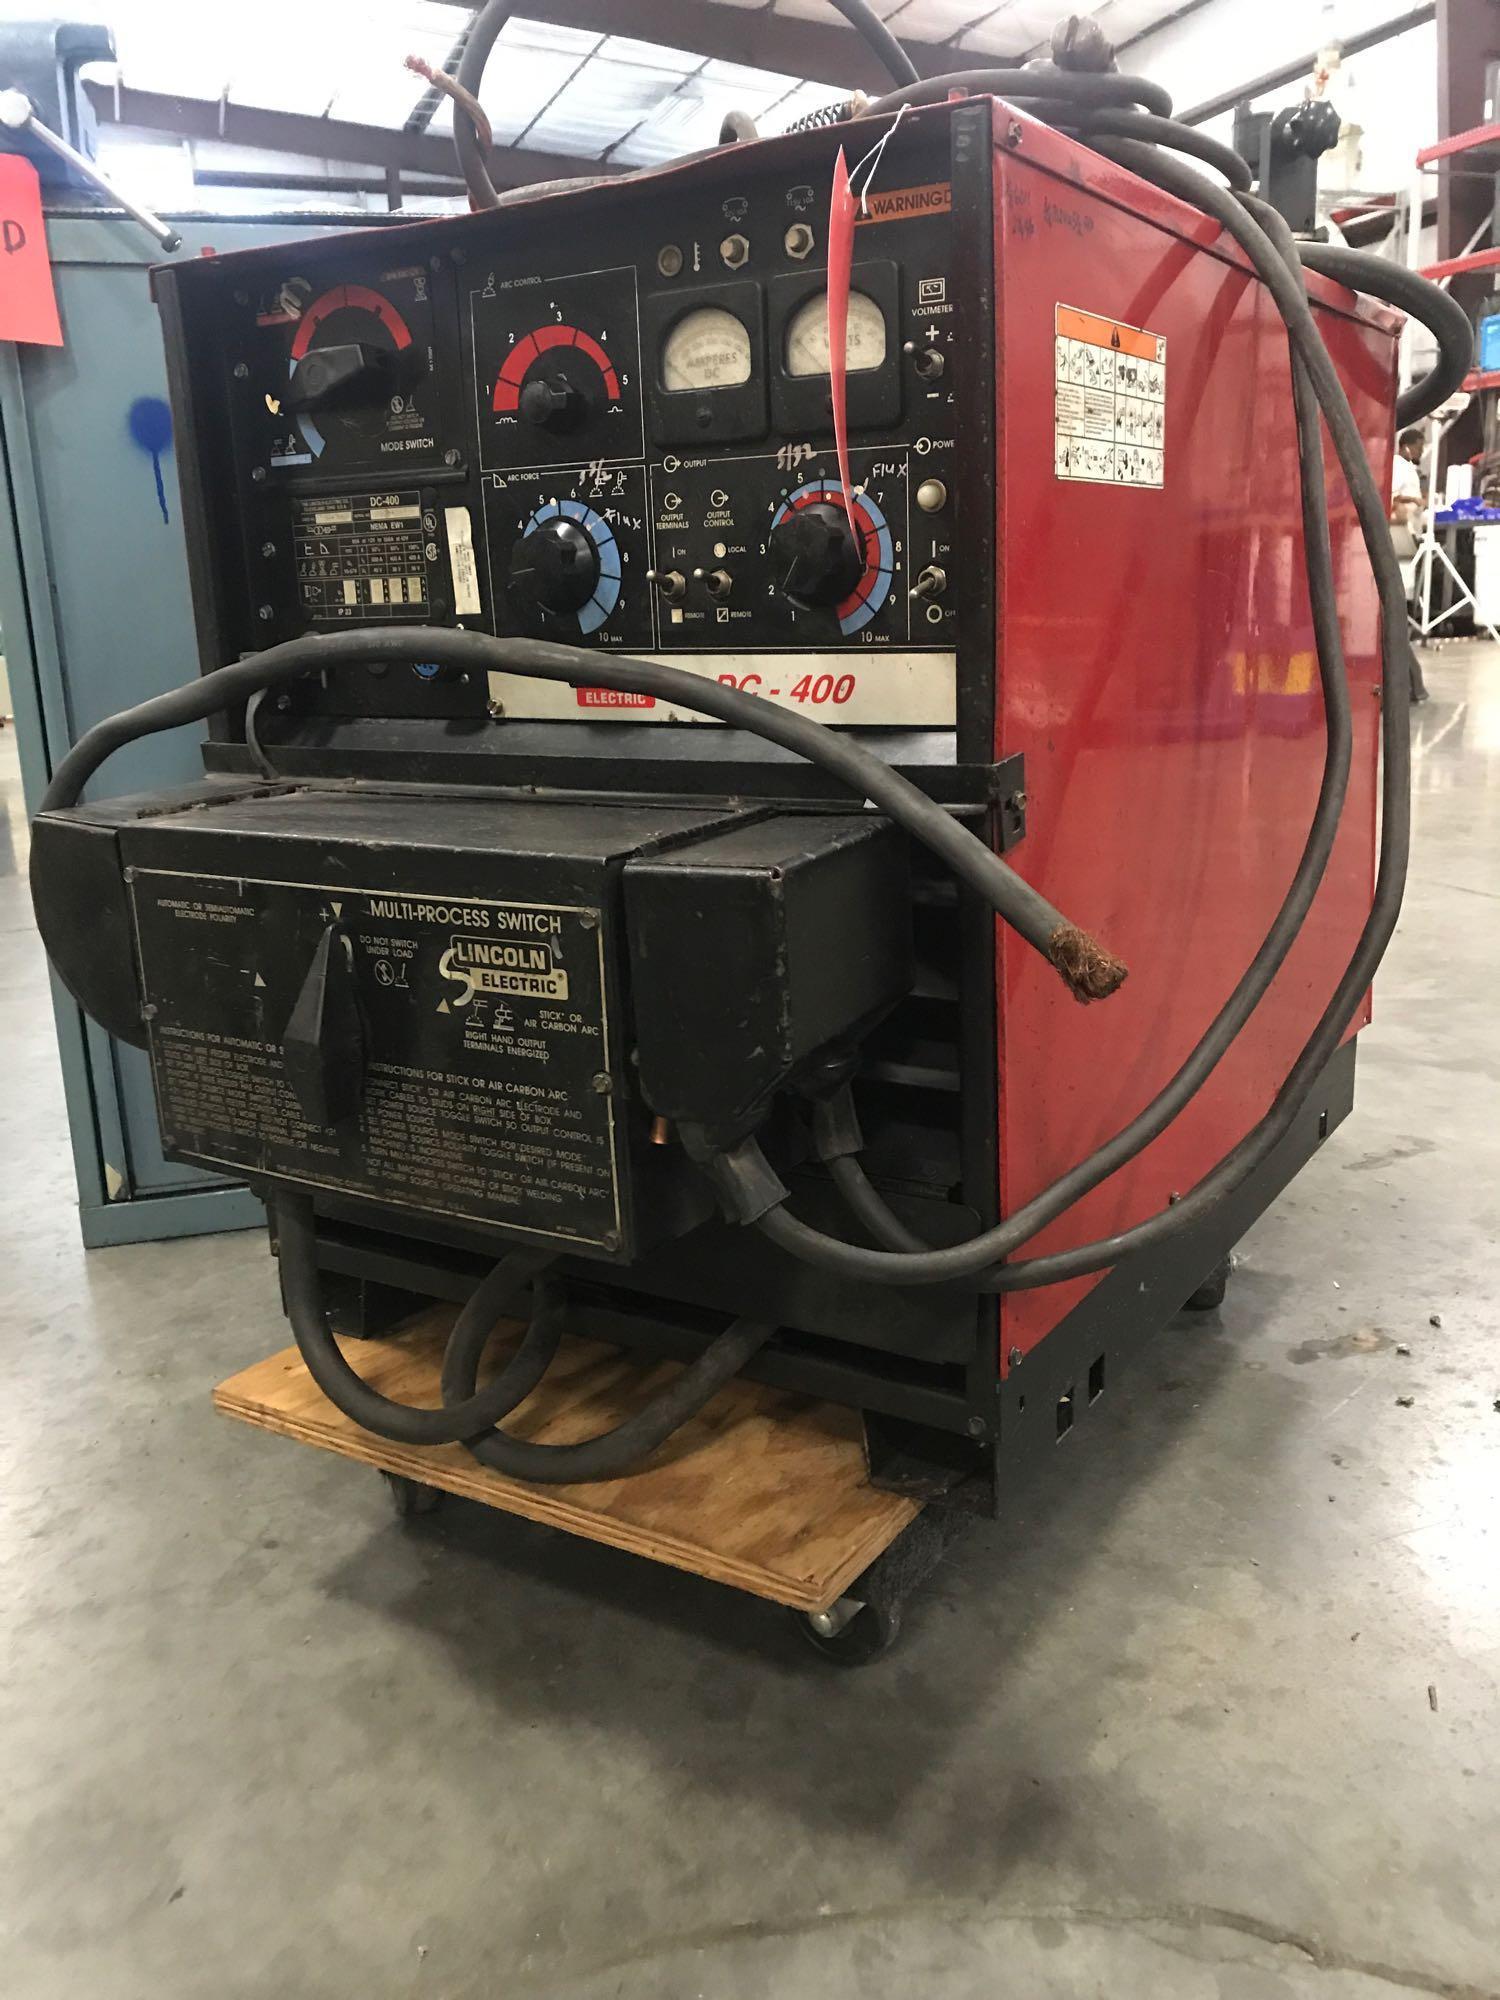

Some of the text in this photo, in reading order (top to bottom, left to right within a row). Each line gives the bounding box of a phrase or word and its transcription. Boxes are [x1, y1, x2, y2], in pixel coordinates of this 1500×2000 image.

[873, 190, 943, 214] WARNING
[500, 276, 542, 289] ARC CONTROL
[556, 311, 563, 322] 3
[912, 304, 954, 317] VOLTMETER
[508, 332, 515, 344] 2
[600, 330, 607, 342] 4
[686, 351, 737, 368] AMPERES
[704, 366, 720, 379] DC
[622, 374, 629, 386] 5
[485, 385, 490, 395] 1
[380, 437, 434, 452] MODE SWITCH
[932, 439, 955, 449] POWE
[684, 459, 707, 469] OUTPUT
[507, 472, 540, 482] ARC FORCE
[797, 472, 804, 484] 5
[570, 488, 577, 498] 6
[877, 492, 884, 503] 7
[369, 495, 400, 507] DC-400
[539, 494, 545, 505] 5
[768, 502, 775, 513] 4
[660, 513, 684, 522] OUTPUT
[706, 510, 731, 520] OUTPUT
[370, 522, 389, 531] NEMA
[517, 520, 524, 530] 4
[656, 521, 690, 530] TERMINALS
[703, 518, 735, 528] CONTROL
[676, 547, 687, 556] ON
[727, 545, 747, 554] LOCAL
[759, 543, 766, 555] 3
[895, 541, 902, 552] 8
[939, 544, 950, 552] ON
[623, 552, 630, 563] 8
[768, 585, 775, 596] 2
[619, 599, 626, 610] 9
[889, 594, 897, 606] 9
[541, 612, 545, 623] 1
[791, 611, 796, 621] 1
[599, 632, 623, 643] 10 MAX
[861, 631, 890, 643] 10 MAX
[789, 673, 856, 703] 400
[585, 692, 647, 705] ELECTRIC
[369, 900, 562, 934] MULTI-PROCESS SWITCH
[360, 935, 419, 950] DO NOT SWITCH
[366, 945, 414, 959] UNDER LOAD
[456, 941, 547, 971] LINCOLN
[481, 972, 558, 995] ELECTRIC
[568, 1012, 581, 1024] OR
[523, 1016, 600, 1037] AIR CARBON ARC
[206, 1032, 221, 1044] FOR
[223, 1035, 264, 1052] AUTOMATIC
[265, 1043, 278, 1055] OR
[464, 1029, 547, 1050] RIGHT HAND OUTPUT
[462, 1039, 550, 1060] TERMINALS ENERGIZED
[426, 1071, 444, 1082] FOR
[446, 1073, 470, 1086] STICK
[471, 1078, 486, 1089] OR
[487, 1080, 504, 1091] AIR
[505, 1083, 546, 1098] CARBON
[547, 1090, 569, 1102] ARC
[390, 1090, 416, 1103] CABLES
[456, 1102, 471, 1112] ON
[473, 1104, 497, 1117] RIGHT
[498, 1109, 517, 1120] SIDE
[519, 1112, 531, 1122] OF
[534, 1114, 553, 1126] BOX
[459, 1092, 493, 1106] CARBON
[495, 1099, 513, 1110] ARC
[516, 1101, 561, 1117] ELECTRODE
[563, 1108, 583, 1120] AND
[406, 1112, 437, 1127] SOURCE
[407, 1104, 439, 1117] SOURCE
[440, 1109, 472, 1122] TOGGLE
[473, 1114, 503, 1128] SWITCH
[505, 1120, 518, 1131] SO
[520, 1122, 550, 1136] OUTPUT
[552, 1128, 593, 1145] CONTROL
[468, 1134, 498, 1148] SWITCH
[499, 1140, 517, 1151] FOR
[518, 1142, 554, 1158] DESIRED
[555, 1149, 583, 1162] MODE
[479, 1146, 513, 1161] TOGGLE
[514, 1152, 545, 1167] SWITCH
[559, 1160, 594, 1176] PRESENT
[550, 1180, 589, 1197] CARBON
[525, 1188, 563, 1204] WELDING
